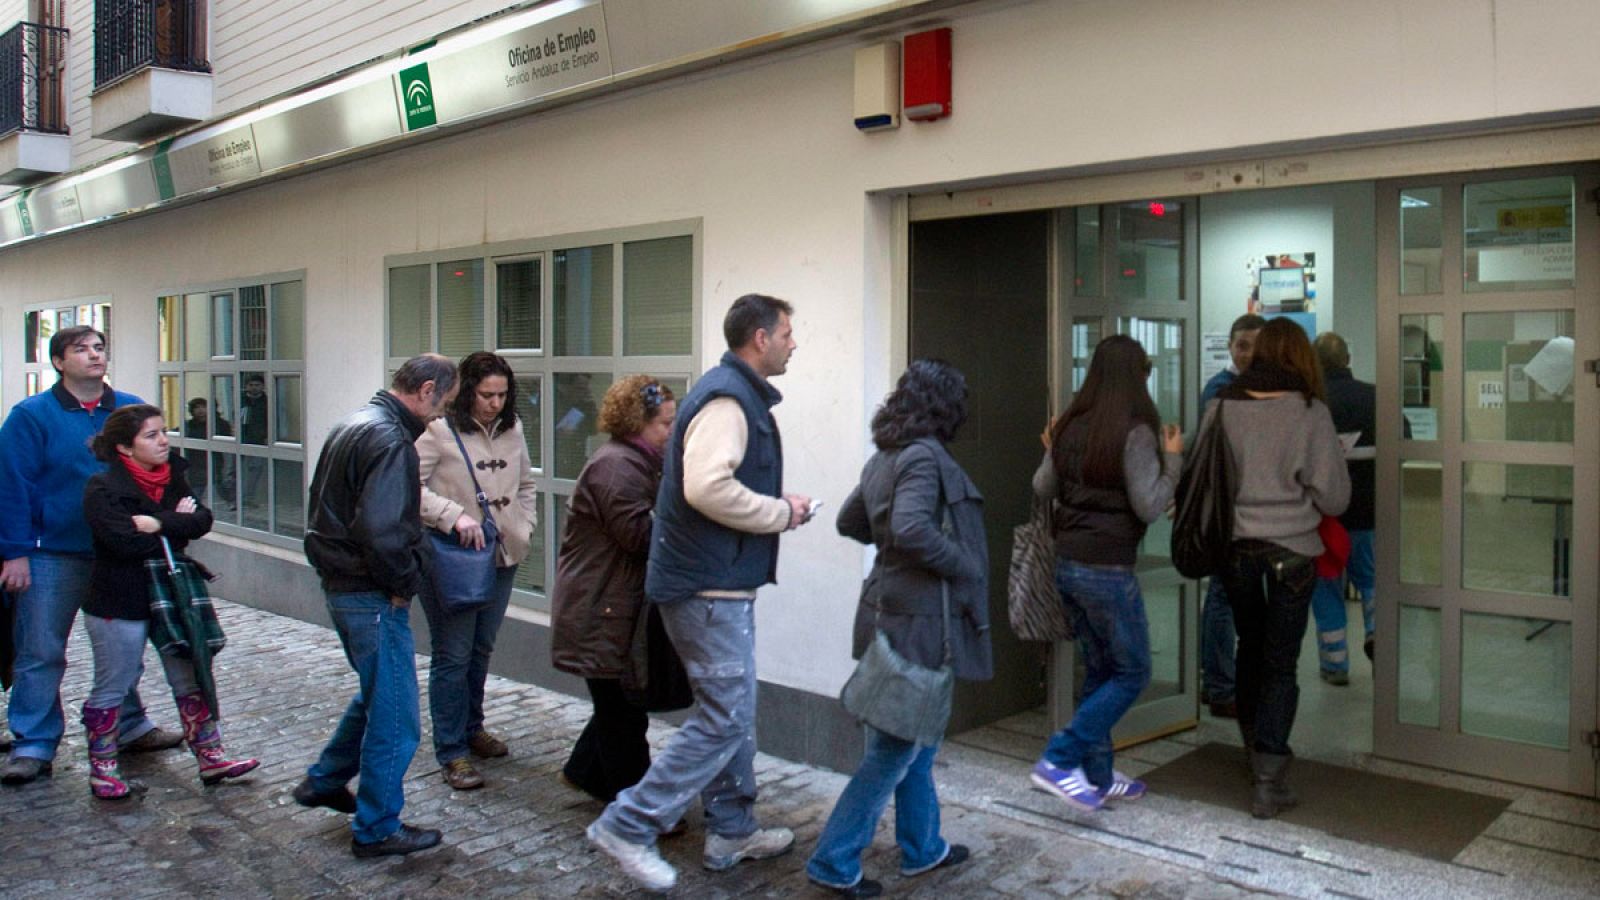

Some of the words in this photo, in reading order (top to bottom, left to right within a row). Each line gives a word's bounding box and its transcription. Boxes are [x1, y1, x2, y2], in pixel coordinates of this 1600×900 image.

[508, 44, 542, 68] Oficina
[543, 38, 557, 57] de
[557, 27, 596, 53] Empleo
[504, 71, 530, 88] Servicio
[531, 63, 559, 80] Andaluz
[561, 58, 571, 72] de
[571, 50, 600, 69] Empleo
